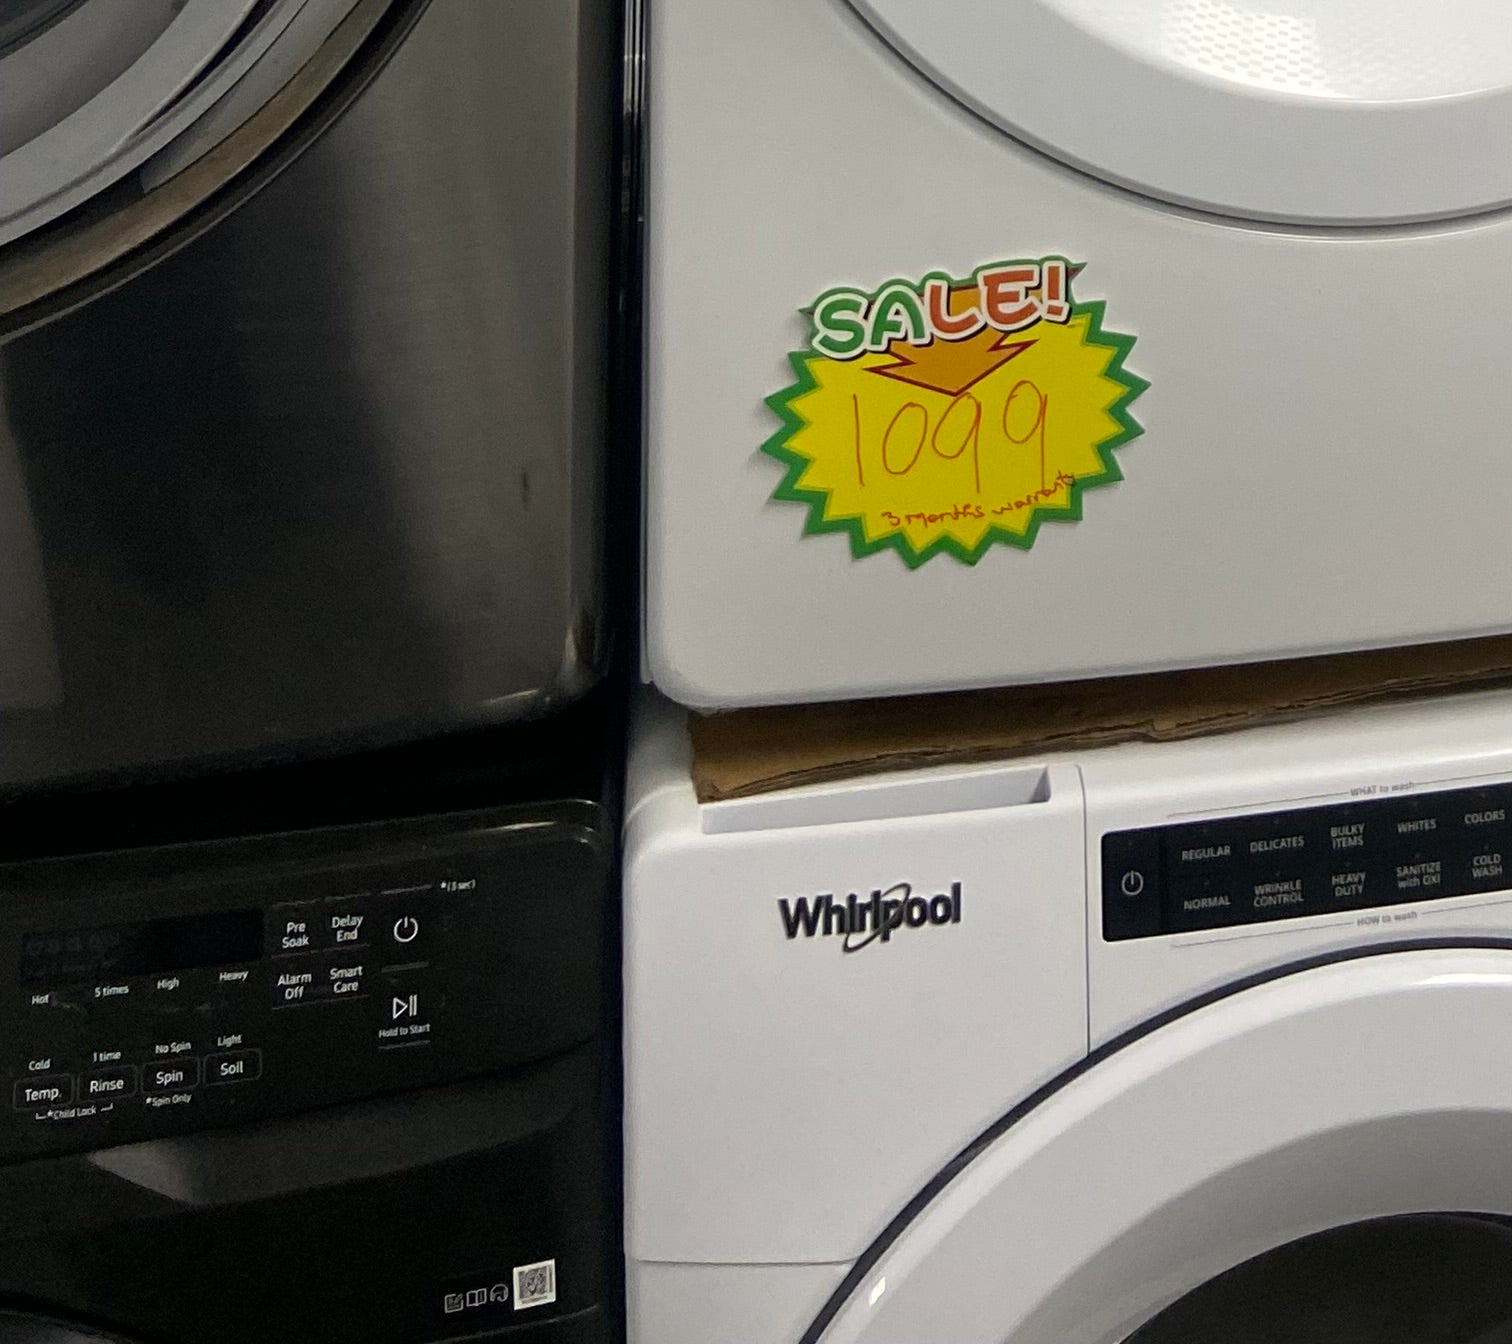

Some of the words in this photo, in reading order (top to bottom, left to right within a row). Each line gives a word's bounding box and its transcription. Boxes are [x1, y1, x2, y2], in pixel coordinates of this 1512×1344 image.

[814, 261, 1068, 357] SALE!
[853, 379, 1048, 494] 1099
[881, 511, 901, 526] 3
[1464, 809, 1505, 824] COLORS
[1330, 823, 1365, 837] BULKY
[1397, 818, 1437, 833] WHITES
[1249, 835, 1305, 853] DELICATES
[1332, 837, 1364, 850] ITEMS
[1181, 845, 1231, 861] REGULAR
[1473, 853, 1501, 867] COLD
[1396, 861, 1441, 877] SANITIZE
[1471, 865, 1503, 879] WASH
[1331, 872, 1366, 886] HEAVY
[1397, 876, 1420, 889] with
[1422, 874, 1441, 887] OXI
[1254, 879, 1302, 895] WRINKLE
[1334, 884, 1364, 897] DUTY
[1183, 895, 1232, 910] NORMAL
[1253, 893, 1304, 908] CONTROL
[777, 881, 962, 943] Whirlpool
[286, 921, 306, 935] Pre
[331, 914, 364, 929] Delay
[281, 935, 310, 949] Soak
[336, 928, 358, 943] End
[219, 970, 249, 983] Heavy
[277, 972, 312, 987] Alarm
[329, 965, 363, 980] Smart
[94, 987, 101, 998] 5
[102, 984, 129, 997] times
[157, 977, 180, 991] High
[333, 980, 359, 994] Care
[284, 986, 304, 1000] Off
[378, 1027, 399, 1038] Hold
[399, 1027, 408, 1036] to
[409, 1023, 431, 1034] Start
[155, 1044, 169, 1054] No
[170, 1040, 192, 1054] Spin
[217, 1034, 242, 1048] Light
[99, 1050, 122, 1062] time
[28, 1058, 51, 1072] Cold
[220, 1060, 244, 1076] Soil
[89, 1078, 124, 1093] Rinse
[156, 1070, 183, 1086] Spin
[24, 1087, 62, 1103] Temp.
[171, 1093, 192, 1105] Only
